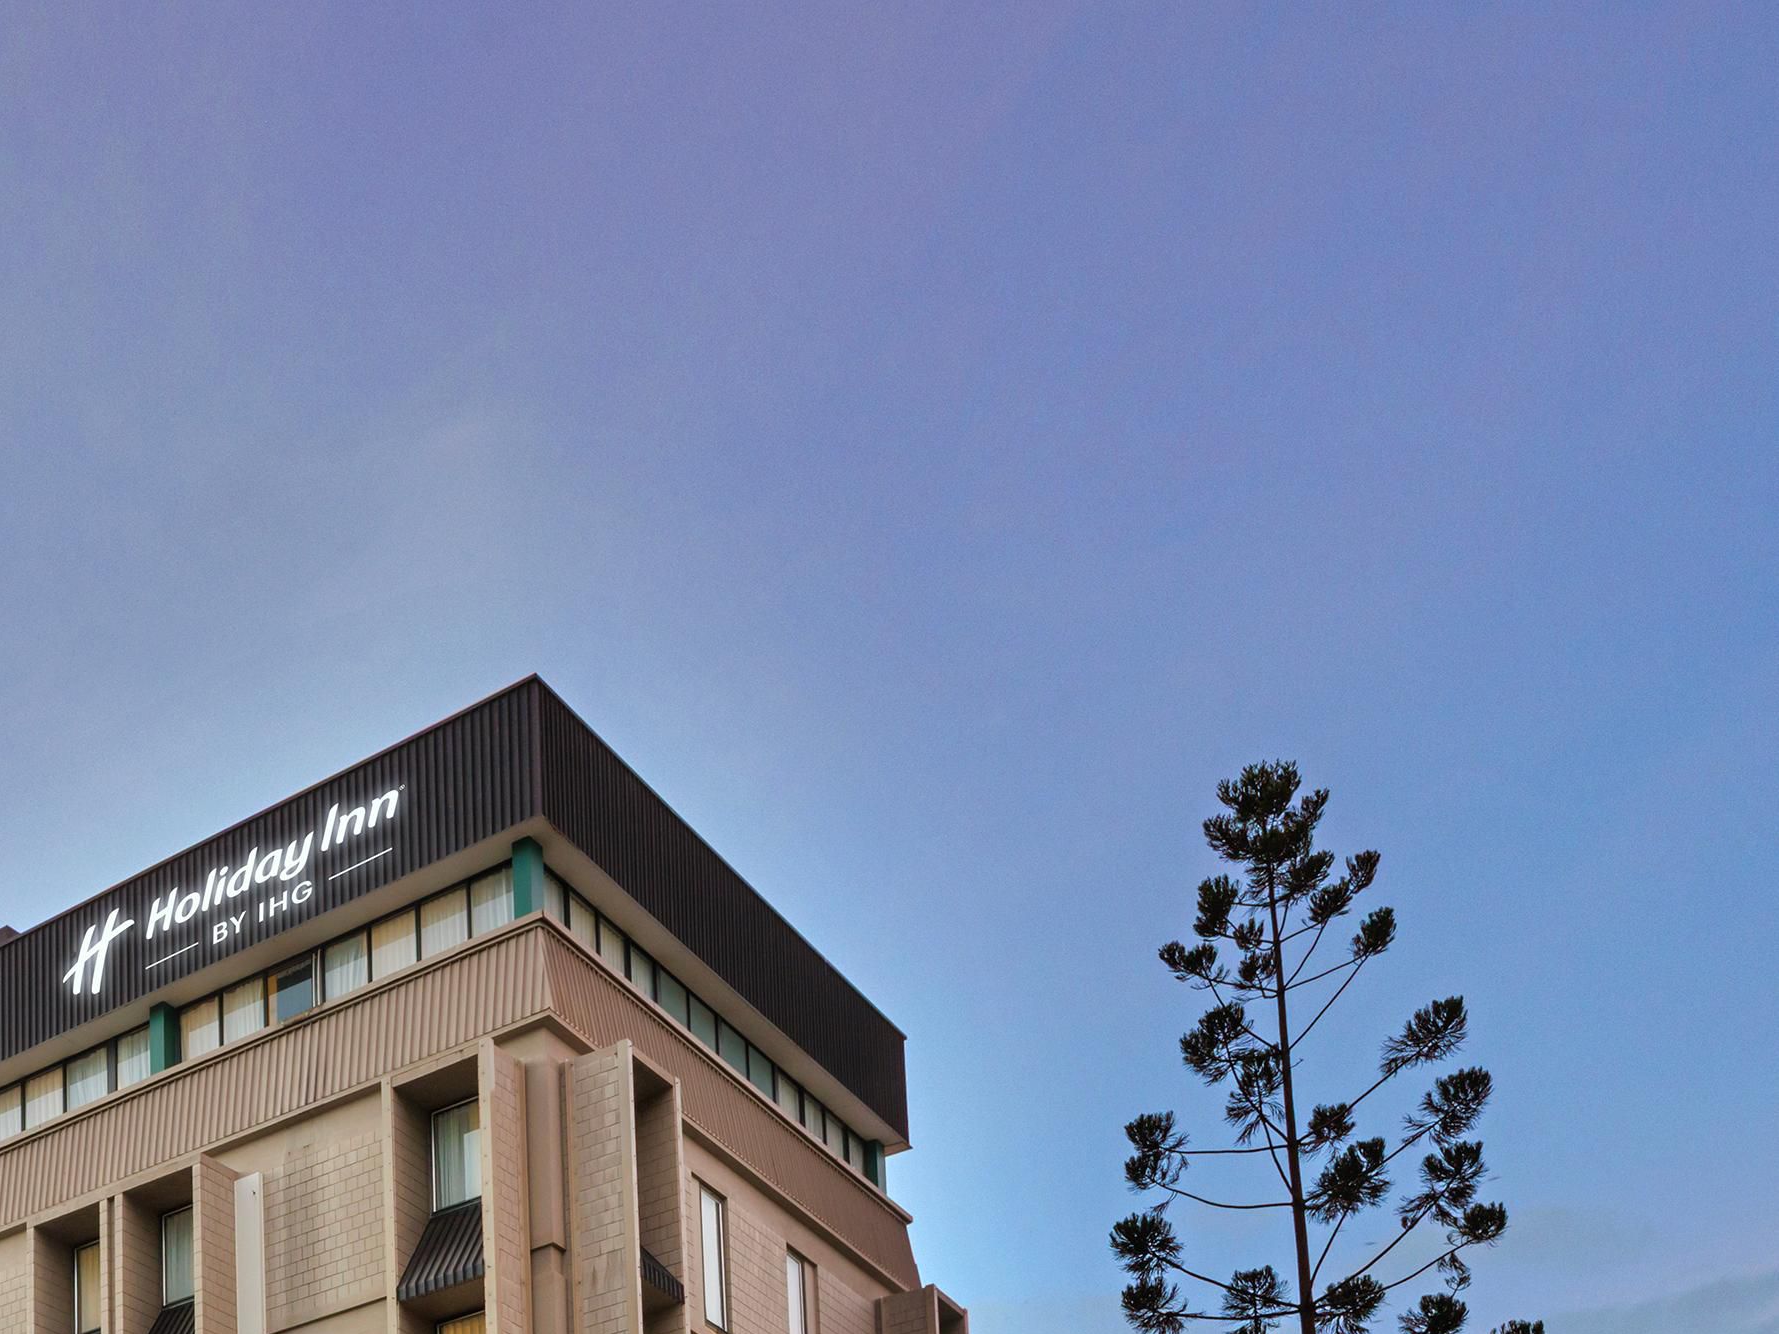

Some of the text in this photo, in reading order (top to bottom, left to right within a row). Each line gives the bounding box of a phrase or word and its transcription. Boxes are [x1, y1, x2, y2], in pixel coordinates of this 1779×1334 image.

[145, 787, 400, 940] Holiday Inn
[212, 880, 313, 945] BY IHG
